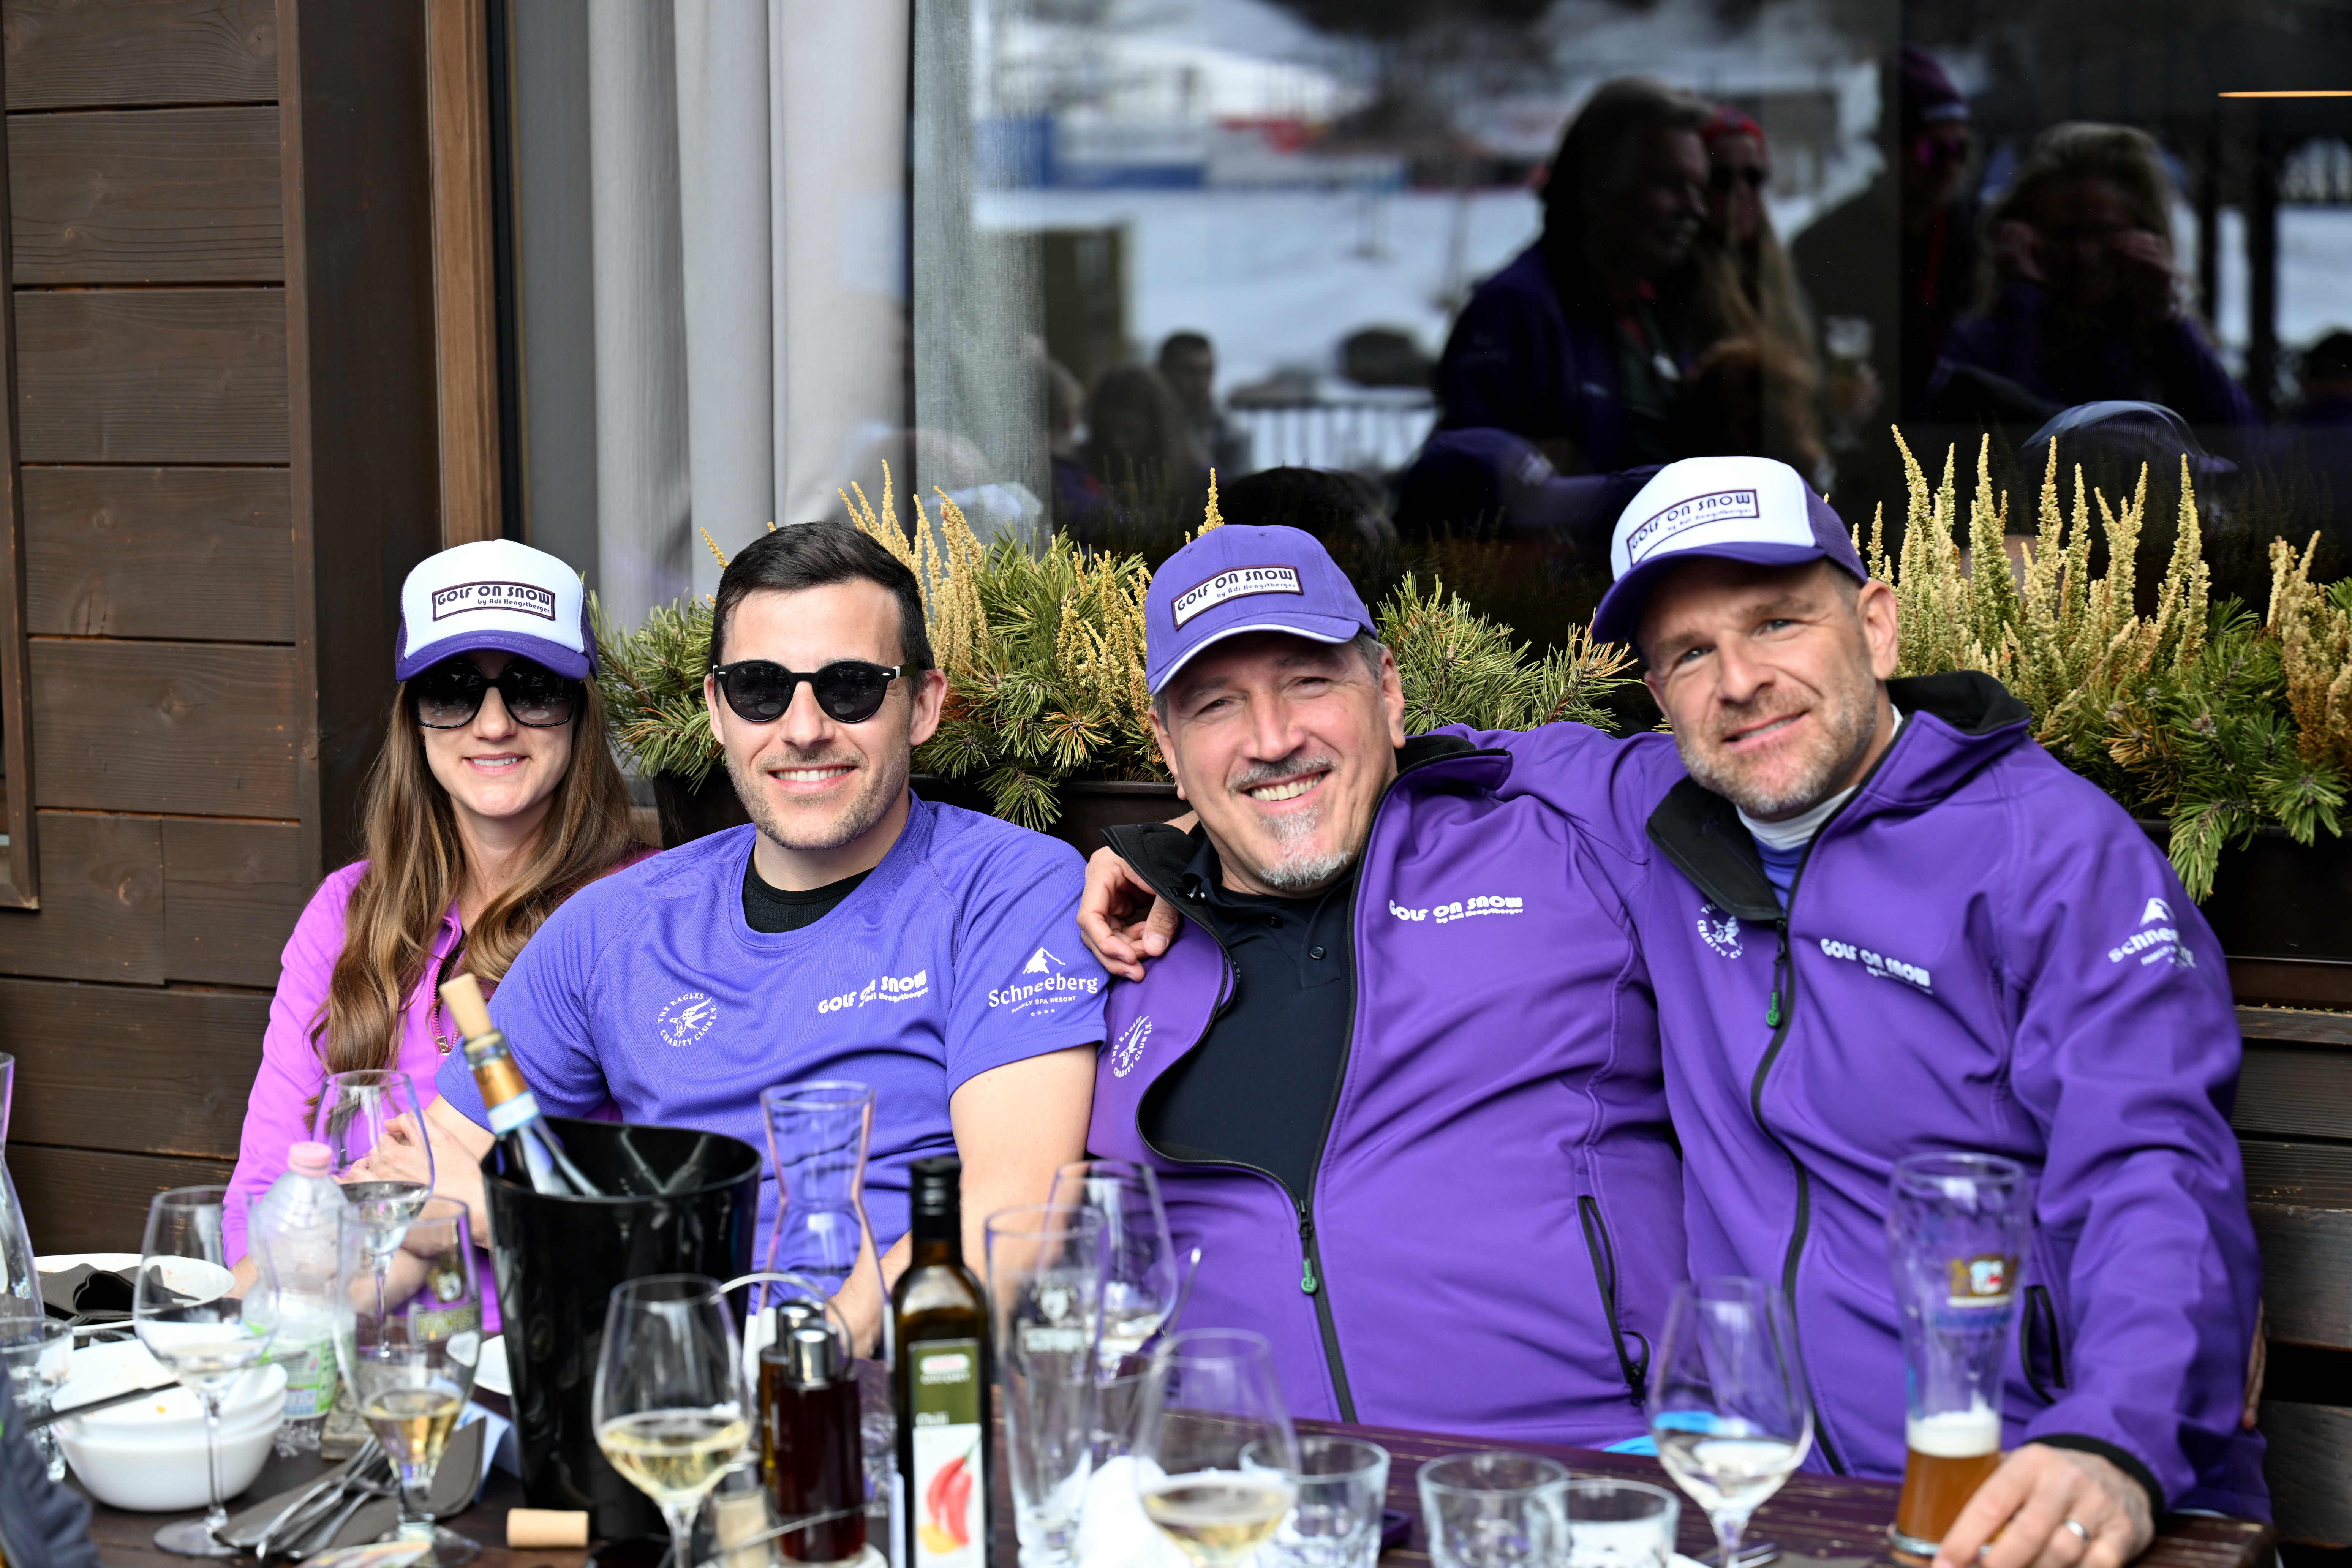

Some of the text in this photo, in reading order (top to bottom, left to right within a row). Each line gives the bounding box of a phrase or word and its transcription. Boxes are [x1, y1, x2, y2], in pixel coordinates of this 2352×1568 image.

[1631, 494, 1750, 549] GOLF ON SNOW
[438, 586, 550, 605] GOLF ON SNOW
[1178, 570, 1293, 611] GOLF ON SNOW
[1228, 585, 1241, 594] Adi
[504, 599, 550, 613] Hengstberger
[1389, 896, 1523, 921] GOLF ON SNOW
[1820, 938, 1858, 961] GOLF
[1859, 948, 1885, 969] ON
[817, 969, 927, 1014] GOLF ON SNOW
[865, 992, 877, 1002] Adi
[988, 972, 1098, 1008] Schneeberg
[657, 992, 704, 1023] THE EAGLES
[1011, 1000, 1033, 1014] FAMILY
[660, 1029, 692, 1047] CHARITY
[694, 1021, 713, 1040] CLUB
